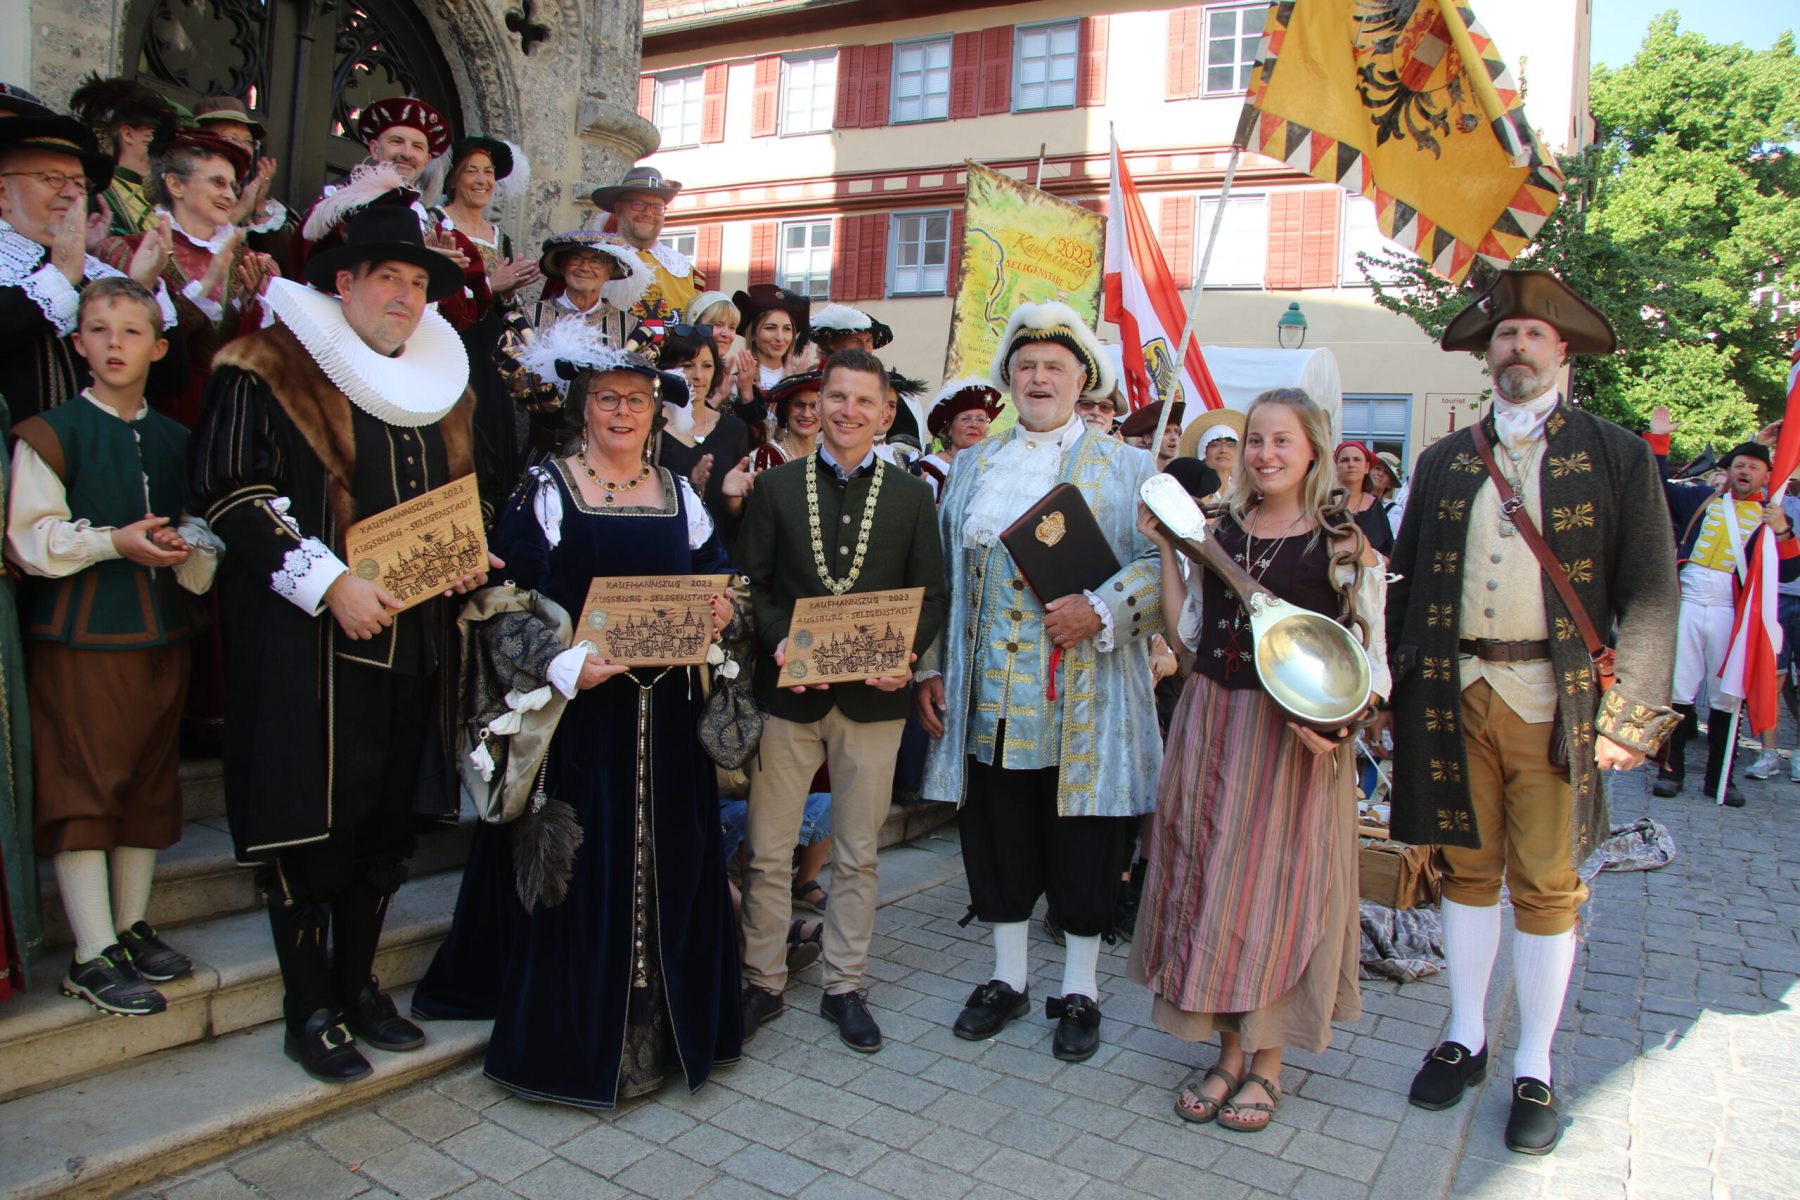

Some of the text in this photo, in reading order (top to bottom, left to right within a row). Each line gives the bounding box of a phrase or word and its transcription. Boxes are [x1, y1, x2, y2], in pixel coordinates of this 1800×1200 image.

[1057, 238, 1093, 269] 2023
[359, 485, 464, 535] KAUFMANNSZUG 2023
[353, 528, 403, 556] AUGSBURG
[410, 496, 474, 531] SELIGENSTADT
[606, 579, 713, 590] KAUFMANNSZUG 2023
[592, 595, 641, 604] AUGSBURG
[650, 593, 713, 603] SELIGENSTAD
[808, 593, 910, 610] KAUFMANNSZUG 2023
[797, 613, 843, 624] AUGSBURG
[851, 606, 915, 620] SELIGENSTADT
